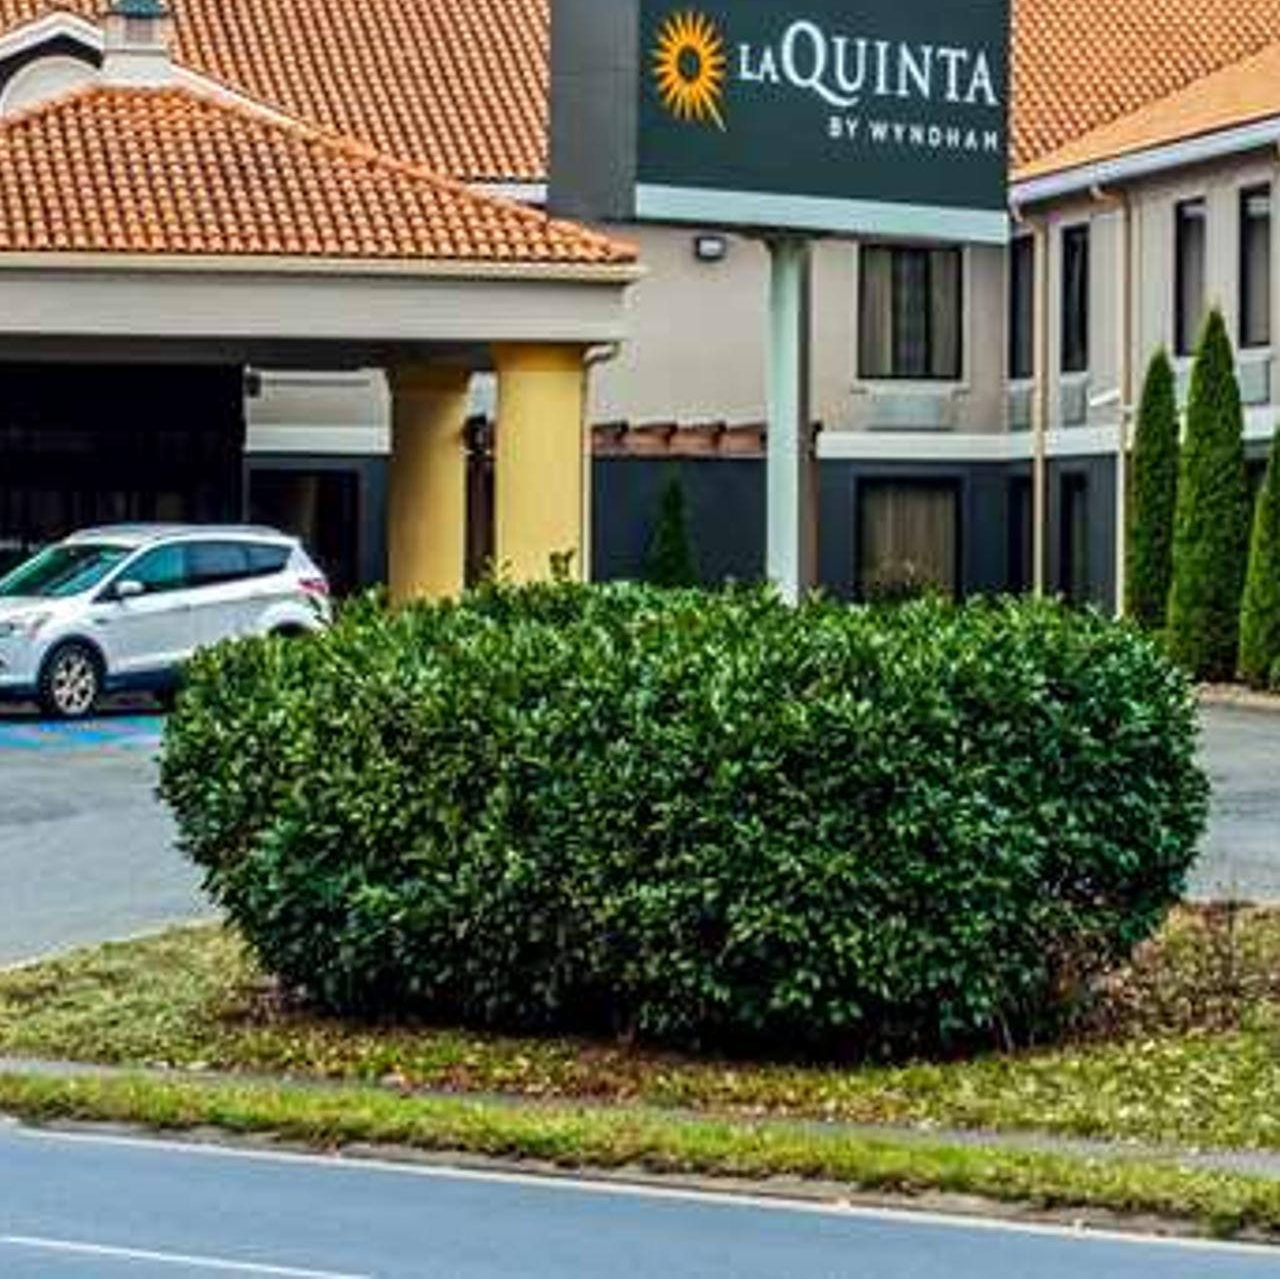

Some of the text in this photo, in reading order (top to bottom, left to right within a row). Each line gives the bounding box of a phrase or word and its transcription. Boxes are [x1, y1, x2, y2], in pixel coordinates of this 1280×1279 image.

[739, 21, 999, 106] LA QUINTA
[830, 117, 998, 150] BY WYNDHAM
